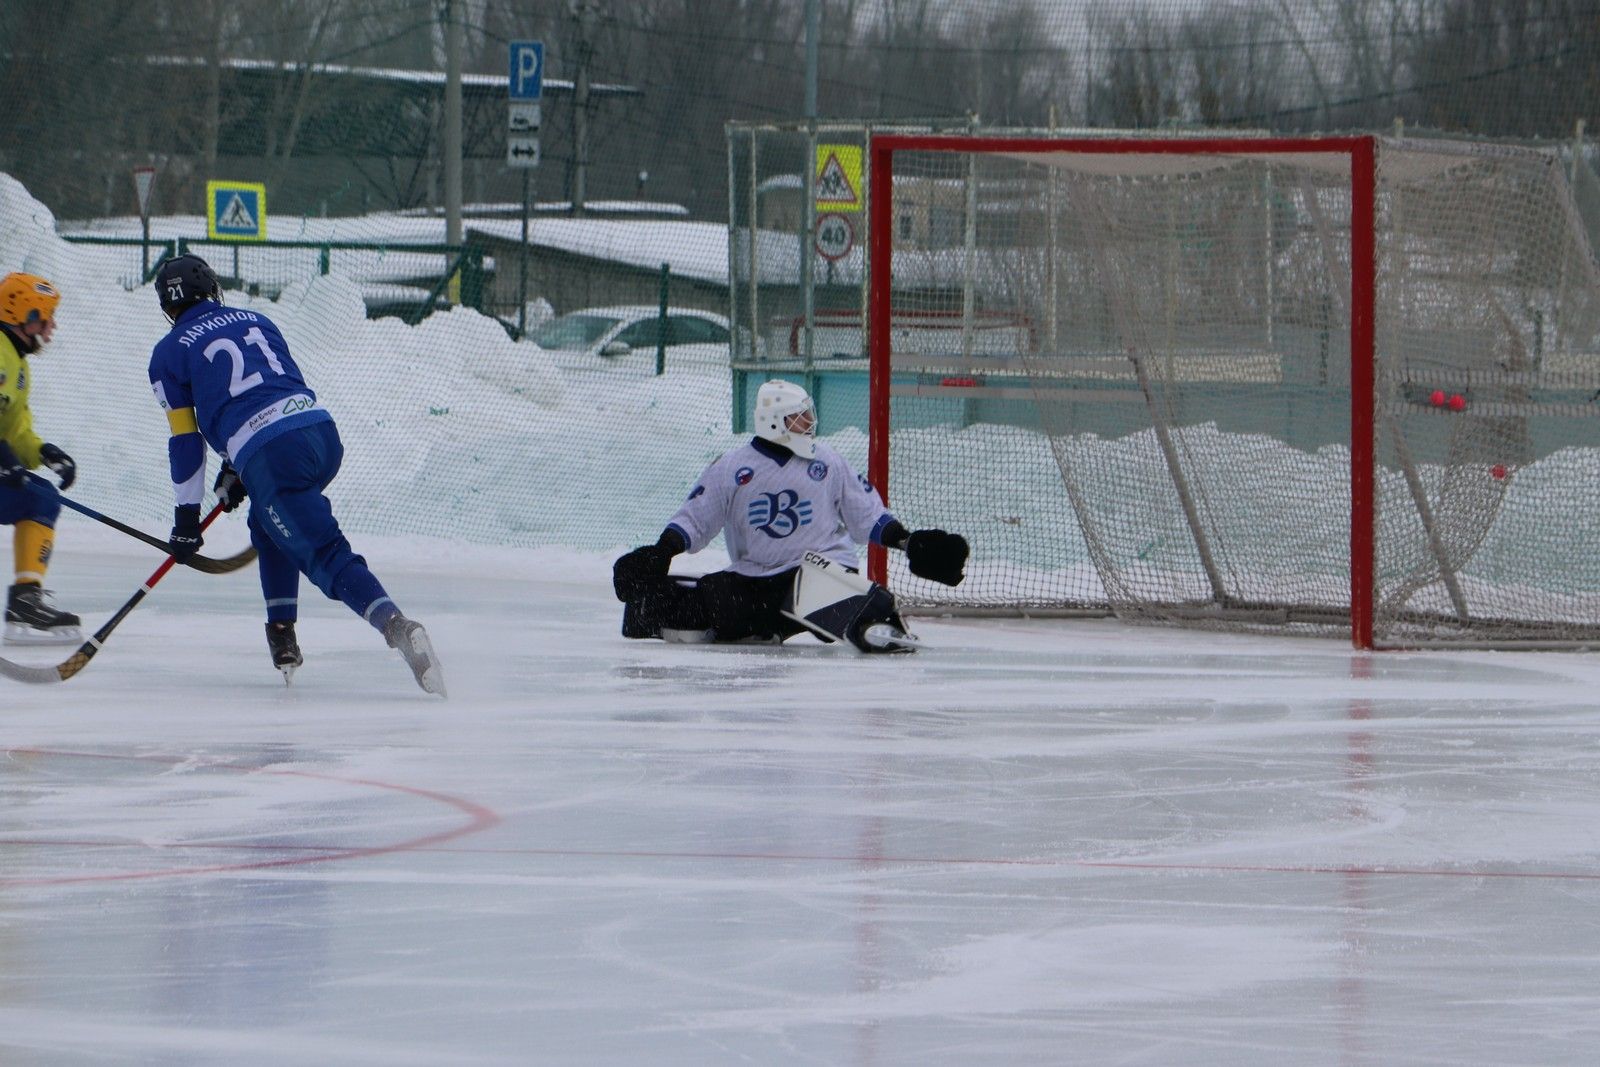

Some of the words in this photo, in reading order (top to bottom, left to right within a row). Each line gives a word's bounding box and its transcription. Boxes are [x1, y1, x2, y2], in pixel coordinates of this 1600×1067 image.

[518, 47, 538, 92] P
[821, 226, 847, 245] 40
[167, 284, 184, 301] 21
[178, 311, 258, 348] ЛАРИОНОВ
[203, 326, 286, 398] 21
[804, 552, 831, 570] CCM
